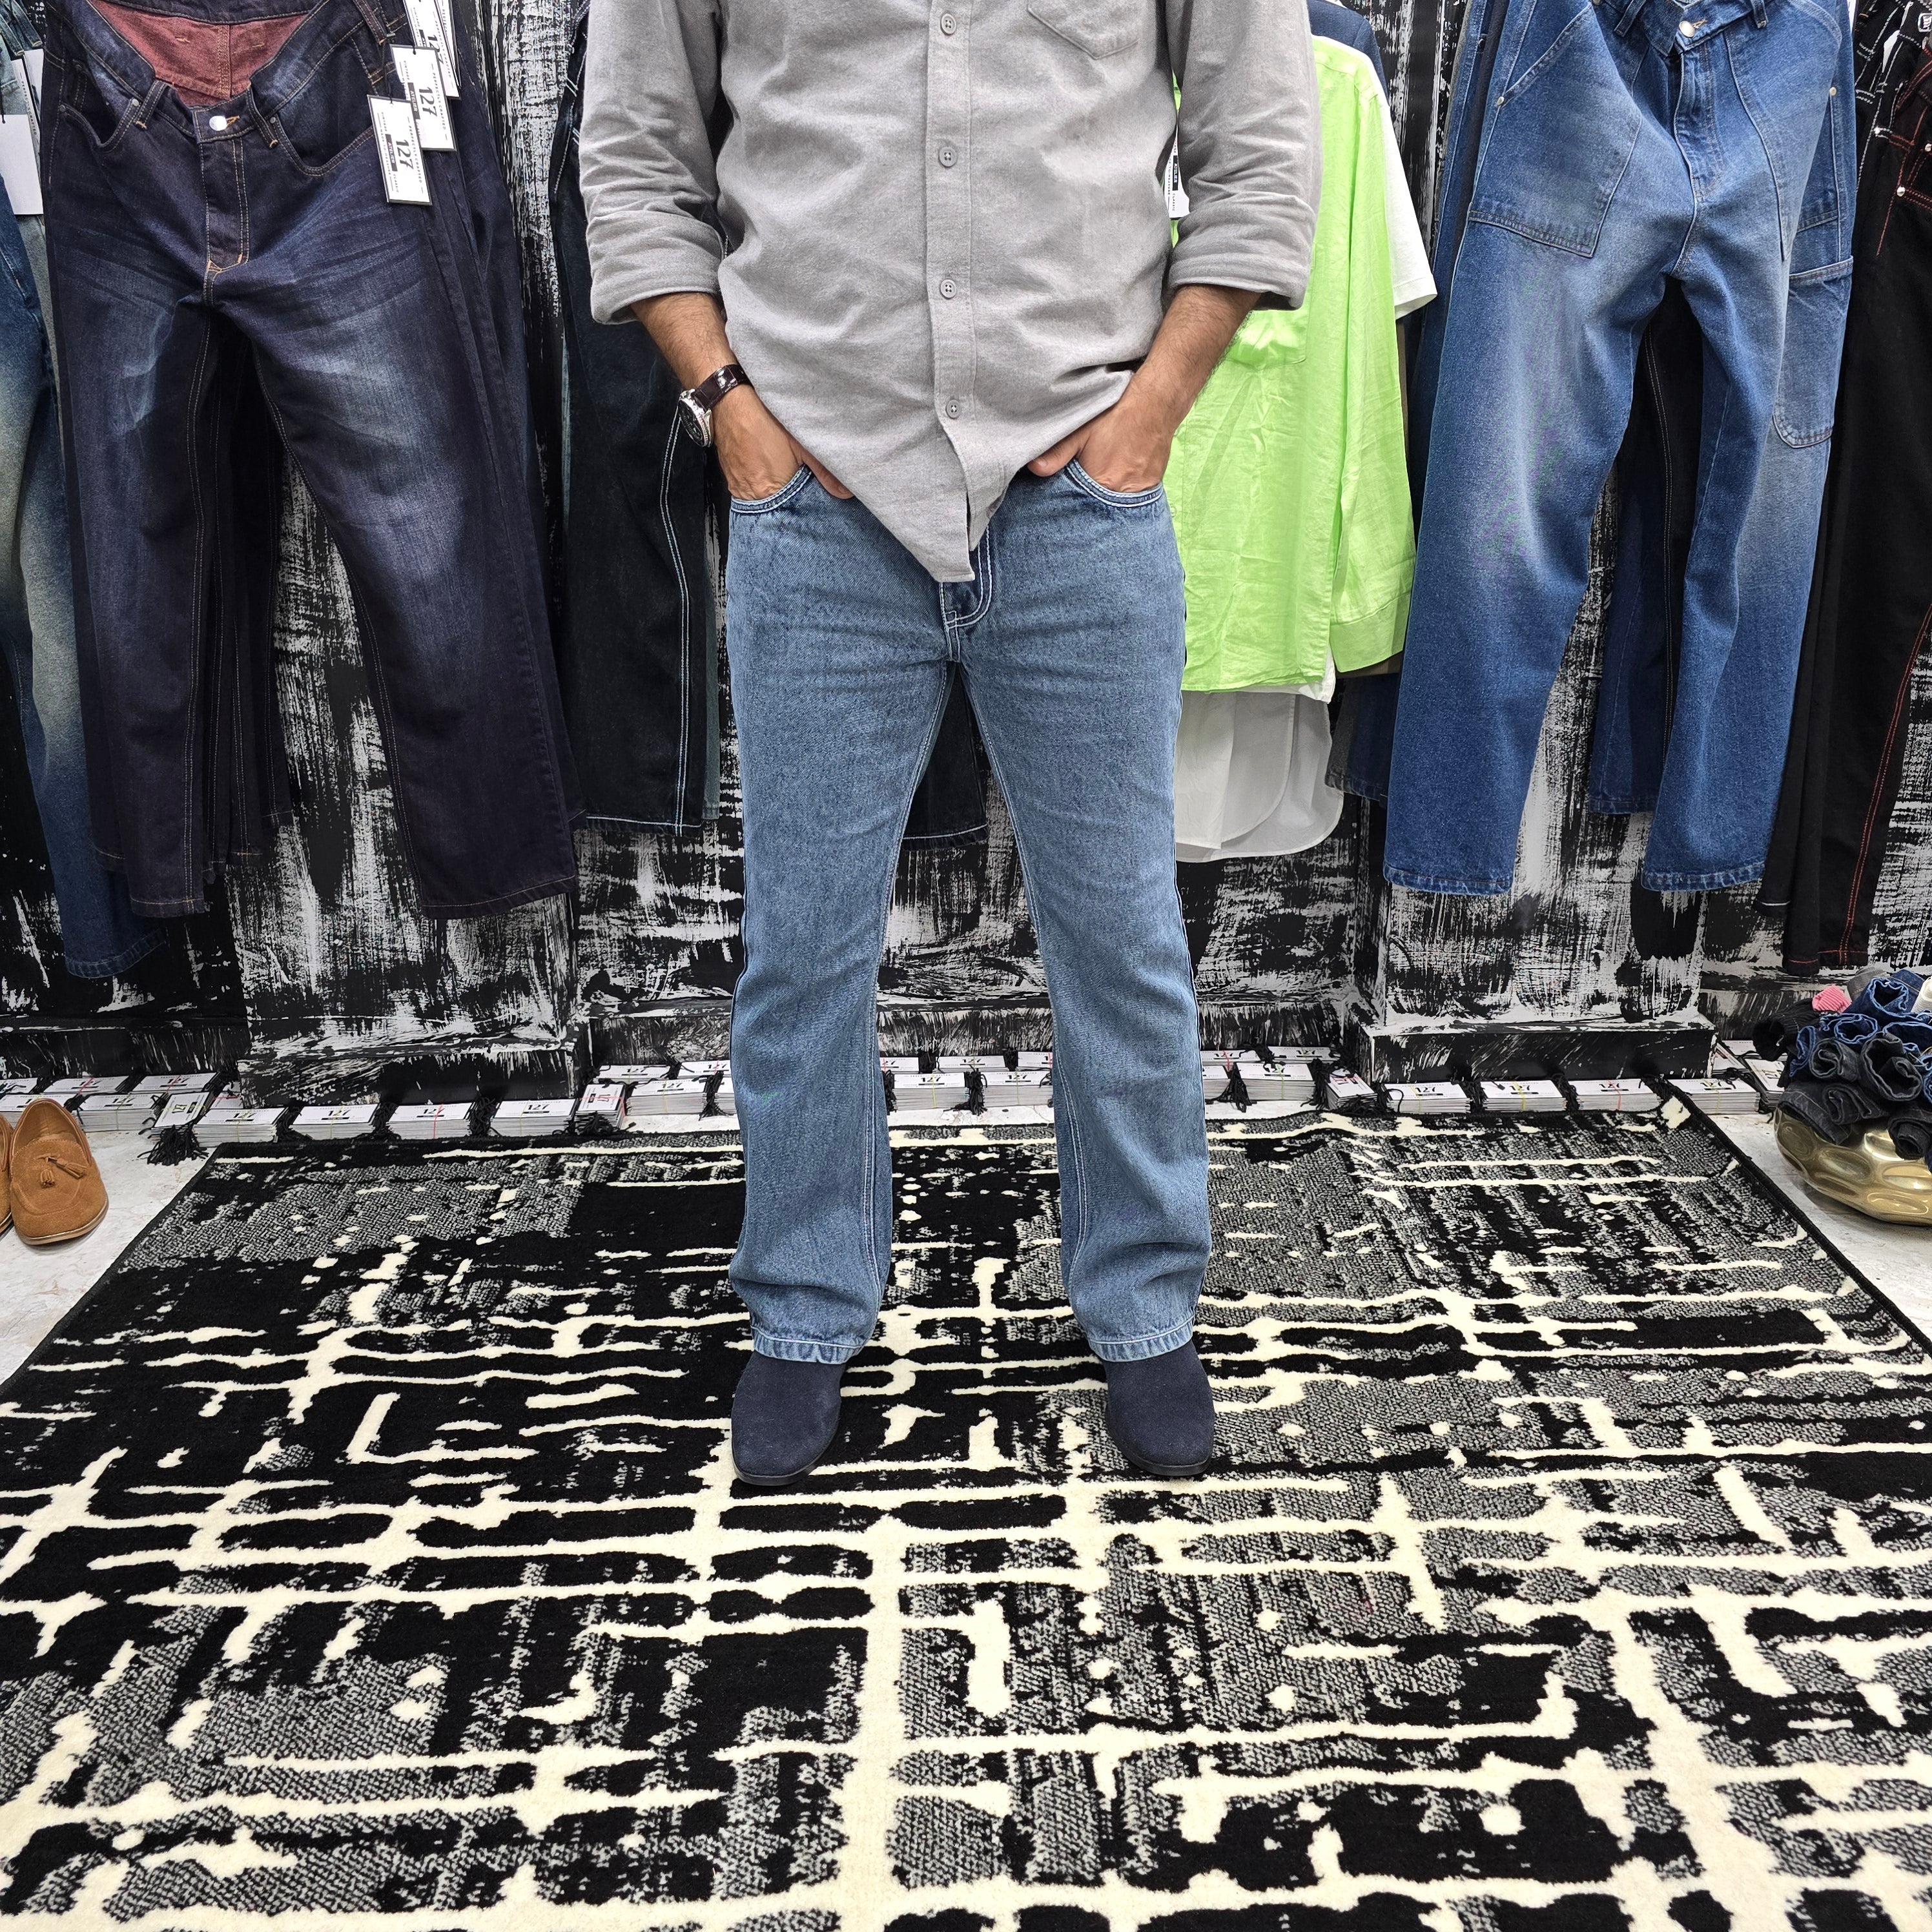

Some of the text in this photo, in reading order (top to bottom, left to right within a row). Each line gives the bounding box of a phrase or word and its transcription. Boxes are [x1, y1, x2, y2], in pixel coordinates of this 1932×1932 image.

[418, 87, 437, 116] 127
[432, 72, 440, 103] PERFECTLY
[395, 139, 413, 169] 127
[408, 125, 416, 156] PERFECTLY
